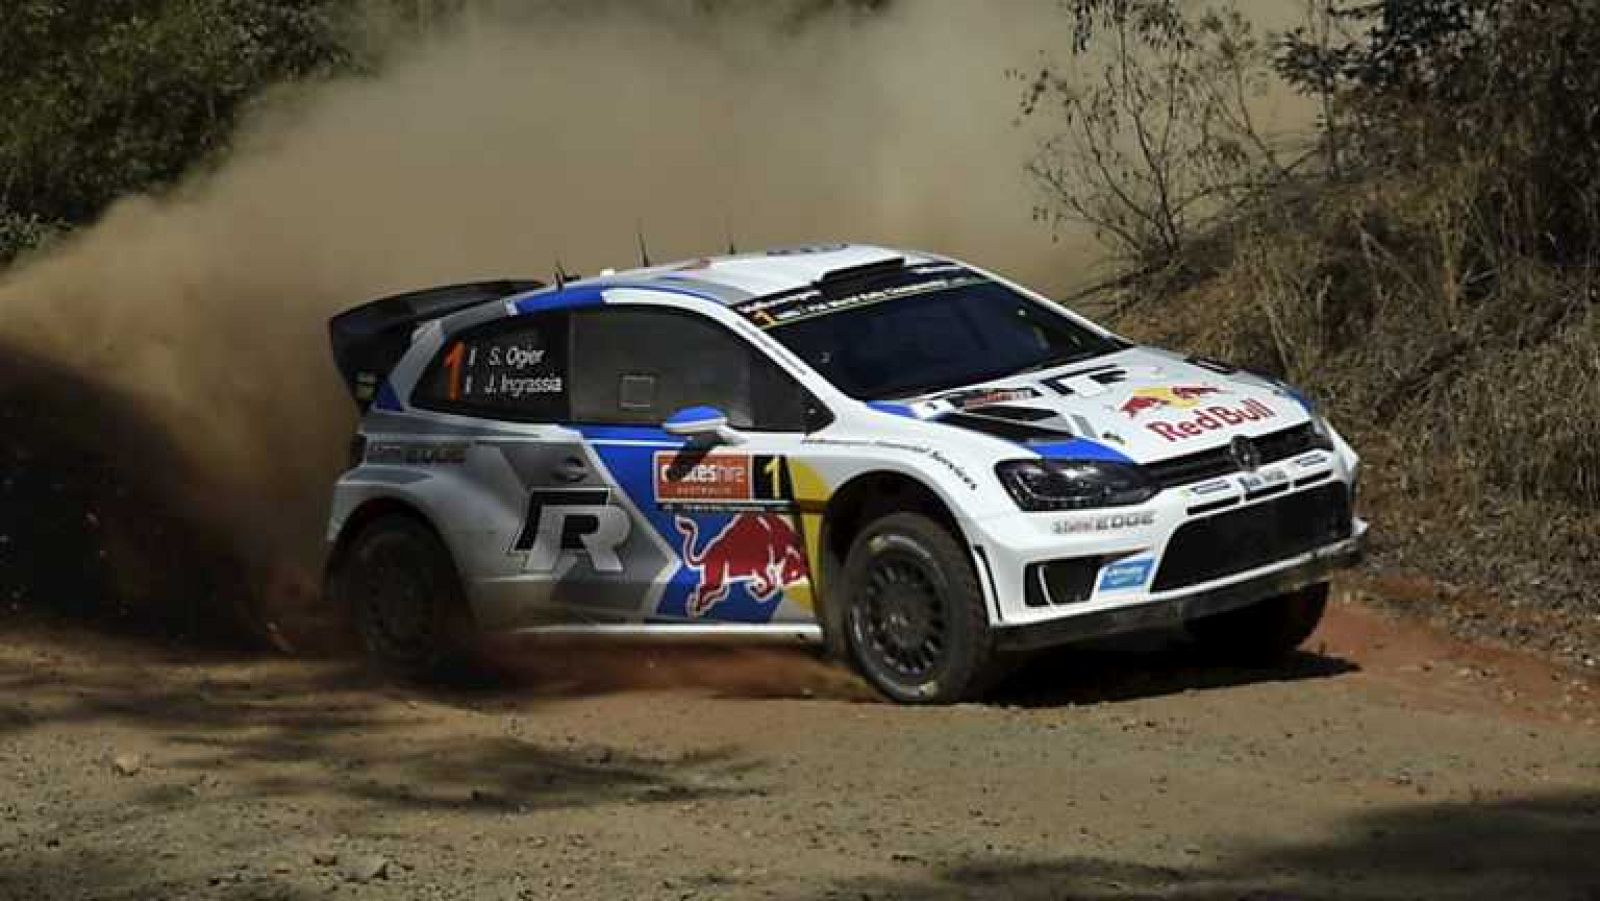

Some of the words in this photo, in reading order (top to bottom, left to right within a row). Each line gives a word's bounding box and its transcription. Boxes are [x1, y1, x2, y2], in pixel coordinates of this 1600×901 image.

[444, 341, 466, 400] 1
[488, 346, 501, 366] S.
[505, 345, 545, 369] Ogier
[484, 374, 497, 394] J.
[501, 372, 563, 397] Ingrassia
[764, 456, 782, 500] 1
